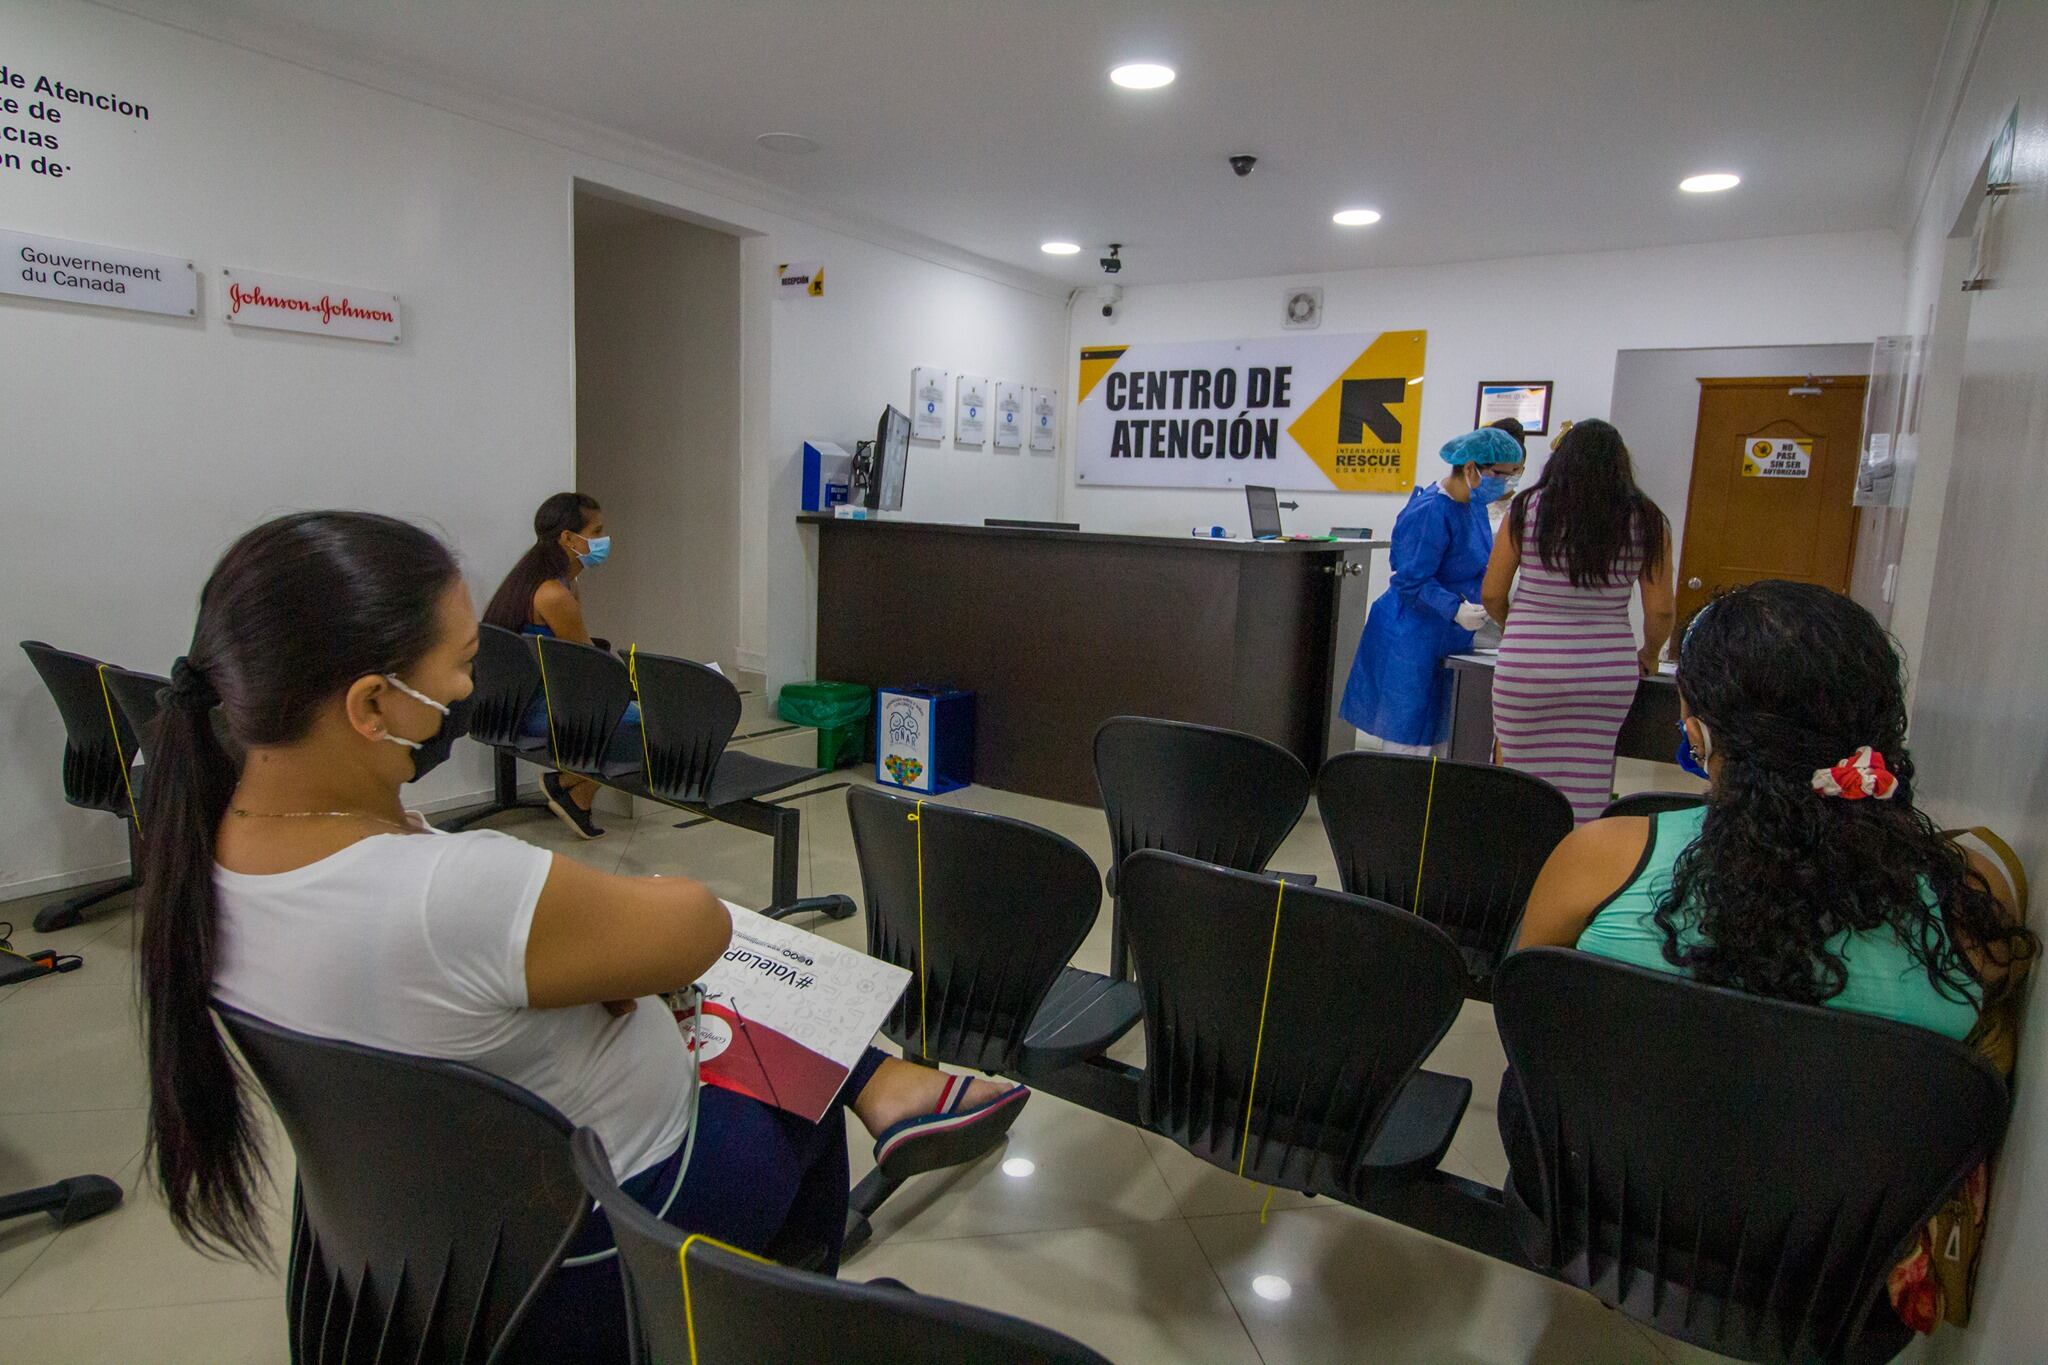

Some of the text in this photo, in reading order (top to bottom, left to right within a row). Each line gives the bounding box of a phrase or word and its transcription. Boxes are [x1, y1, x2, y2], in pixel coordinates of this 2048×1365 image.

[34, 75, 149, 121] Atencion
[29, 101, 62, 123] de
[20, 246, 162, 282] Gouvernement
[22, 267, 126, 294] du Canada
[1106, 366, 1292, 411] CENTRO DE
[1110, 410, 1279, 460] ATENCIÓN
[1335, 447, 1400, 455] INTERNATIONAL
[1776, 452, 1796, 460] PASE
[1782, 444, 1794, 452] NO
[1335, 455, 1400, 467] RESCUE
[1770, 461, 1801, 469] SIN SER
